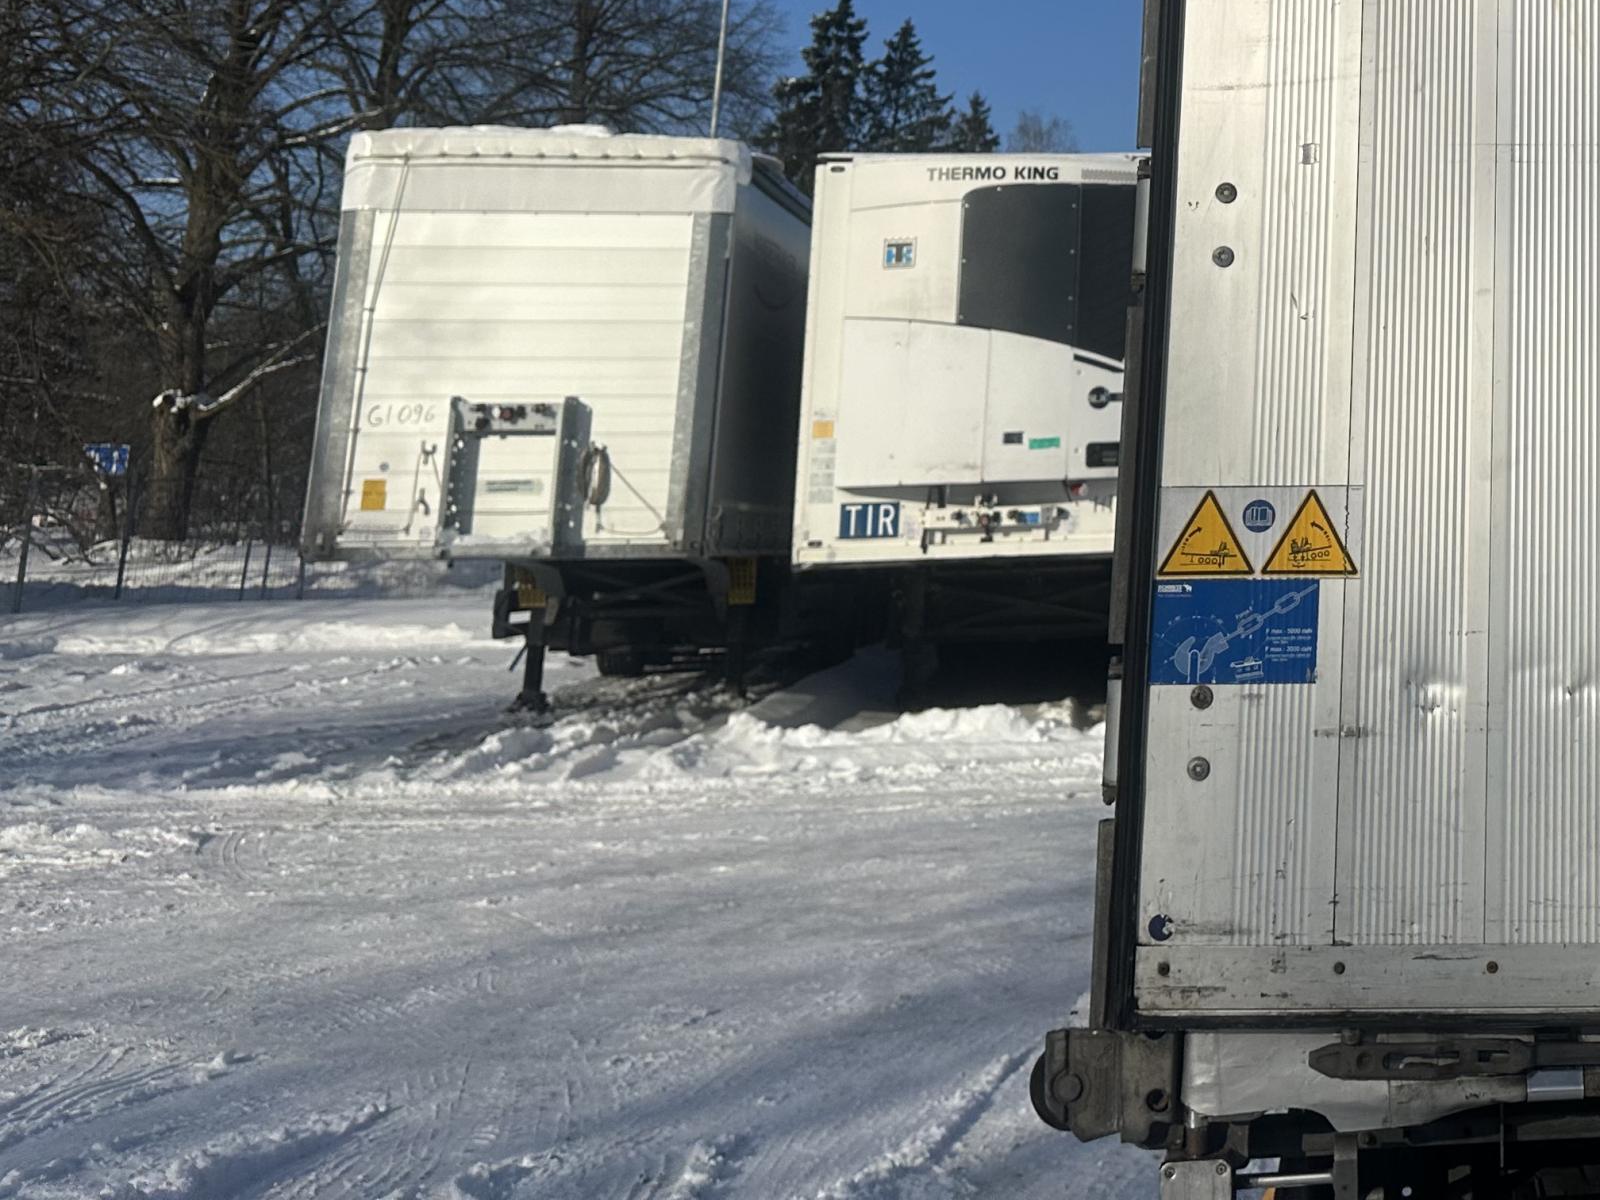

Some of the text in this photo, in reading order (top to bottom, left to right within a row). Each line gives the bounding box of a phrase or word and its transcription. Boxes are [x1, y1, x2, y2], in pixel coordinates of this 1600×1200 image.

[926, 166, 1059, 181] THERMO KING
[845, 504, 895, 536] TIR
